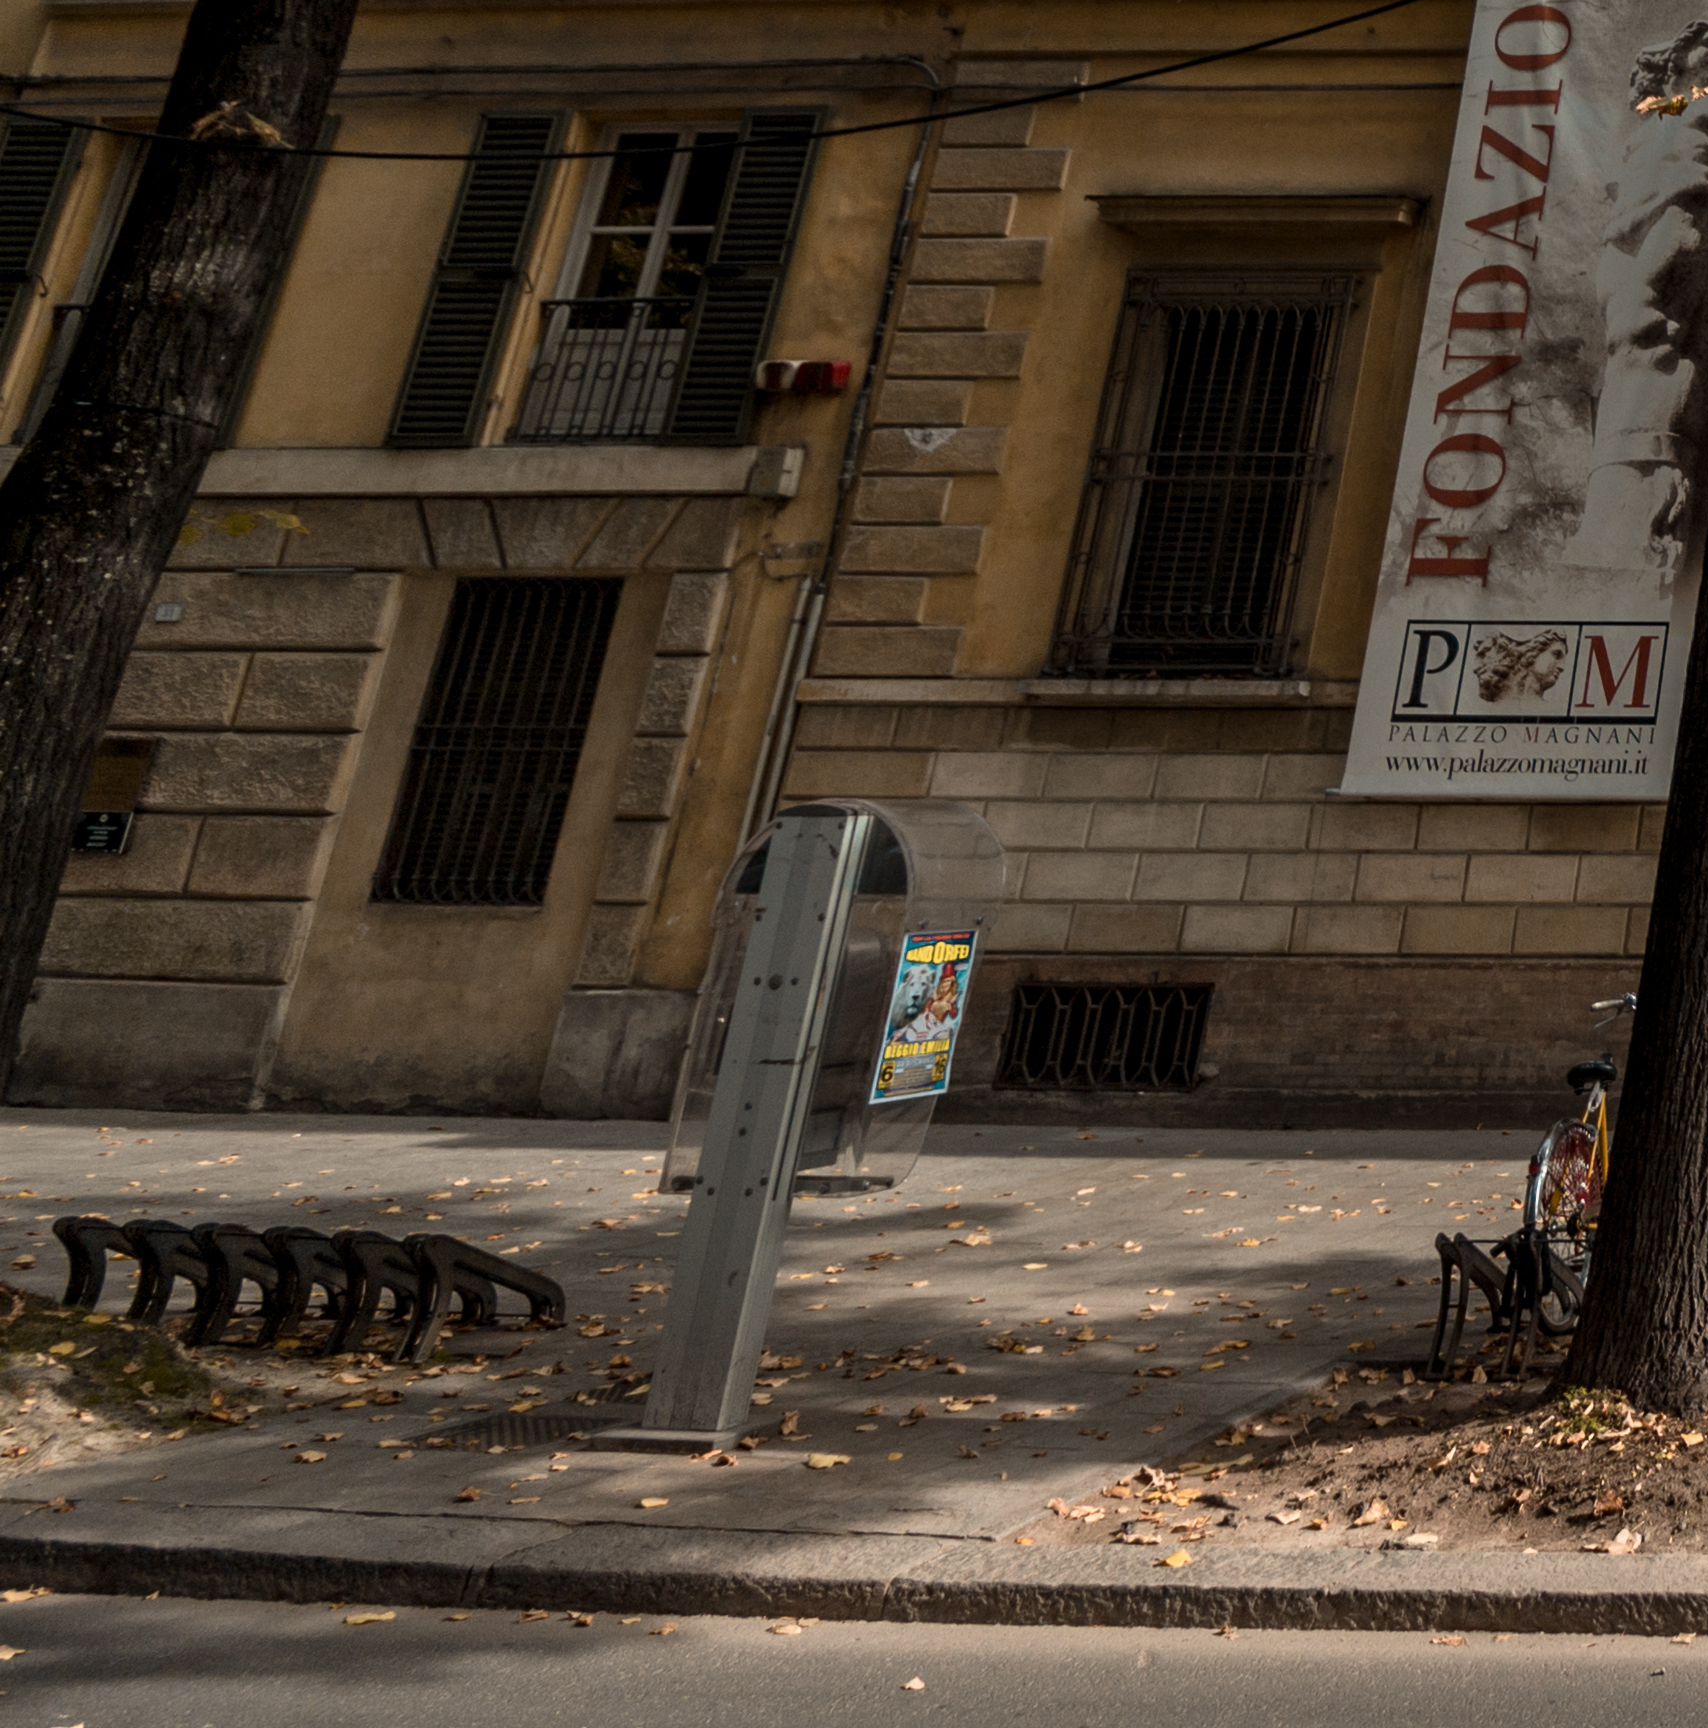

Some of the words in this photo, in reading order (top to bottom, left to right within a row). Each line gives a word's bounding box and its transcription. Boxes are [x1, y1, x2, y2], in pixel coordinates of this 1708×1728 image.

[1388, 724, 1508, 744] PALAZZO
[1522, 725, 1656, 745] MAGNANI
[1385, 748, 1648, 782] www.palazzomagnani.it
[881, 1065, 894, 1083] 6
